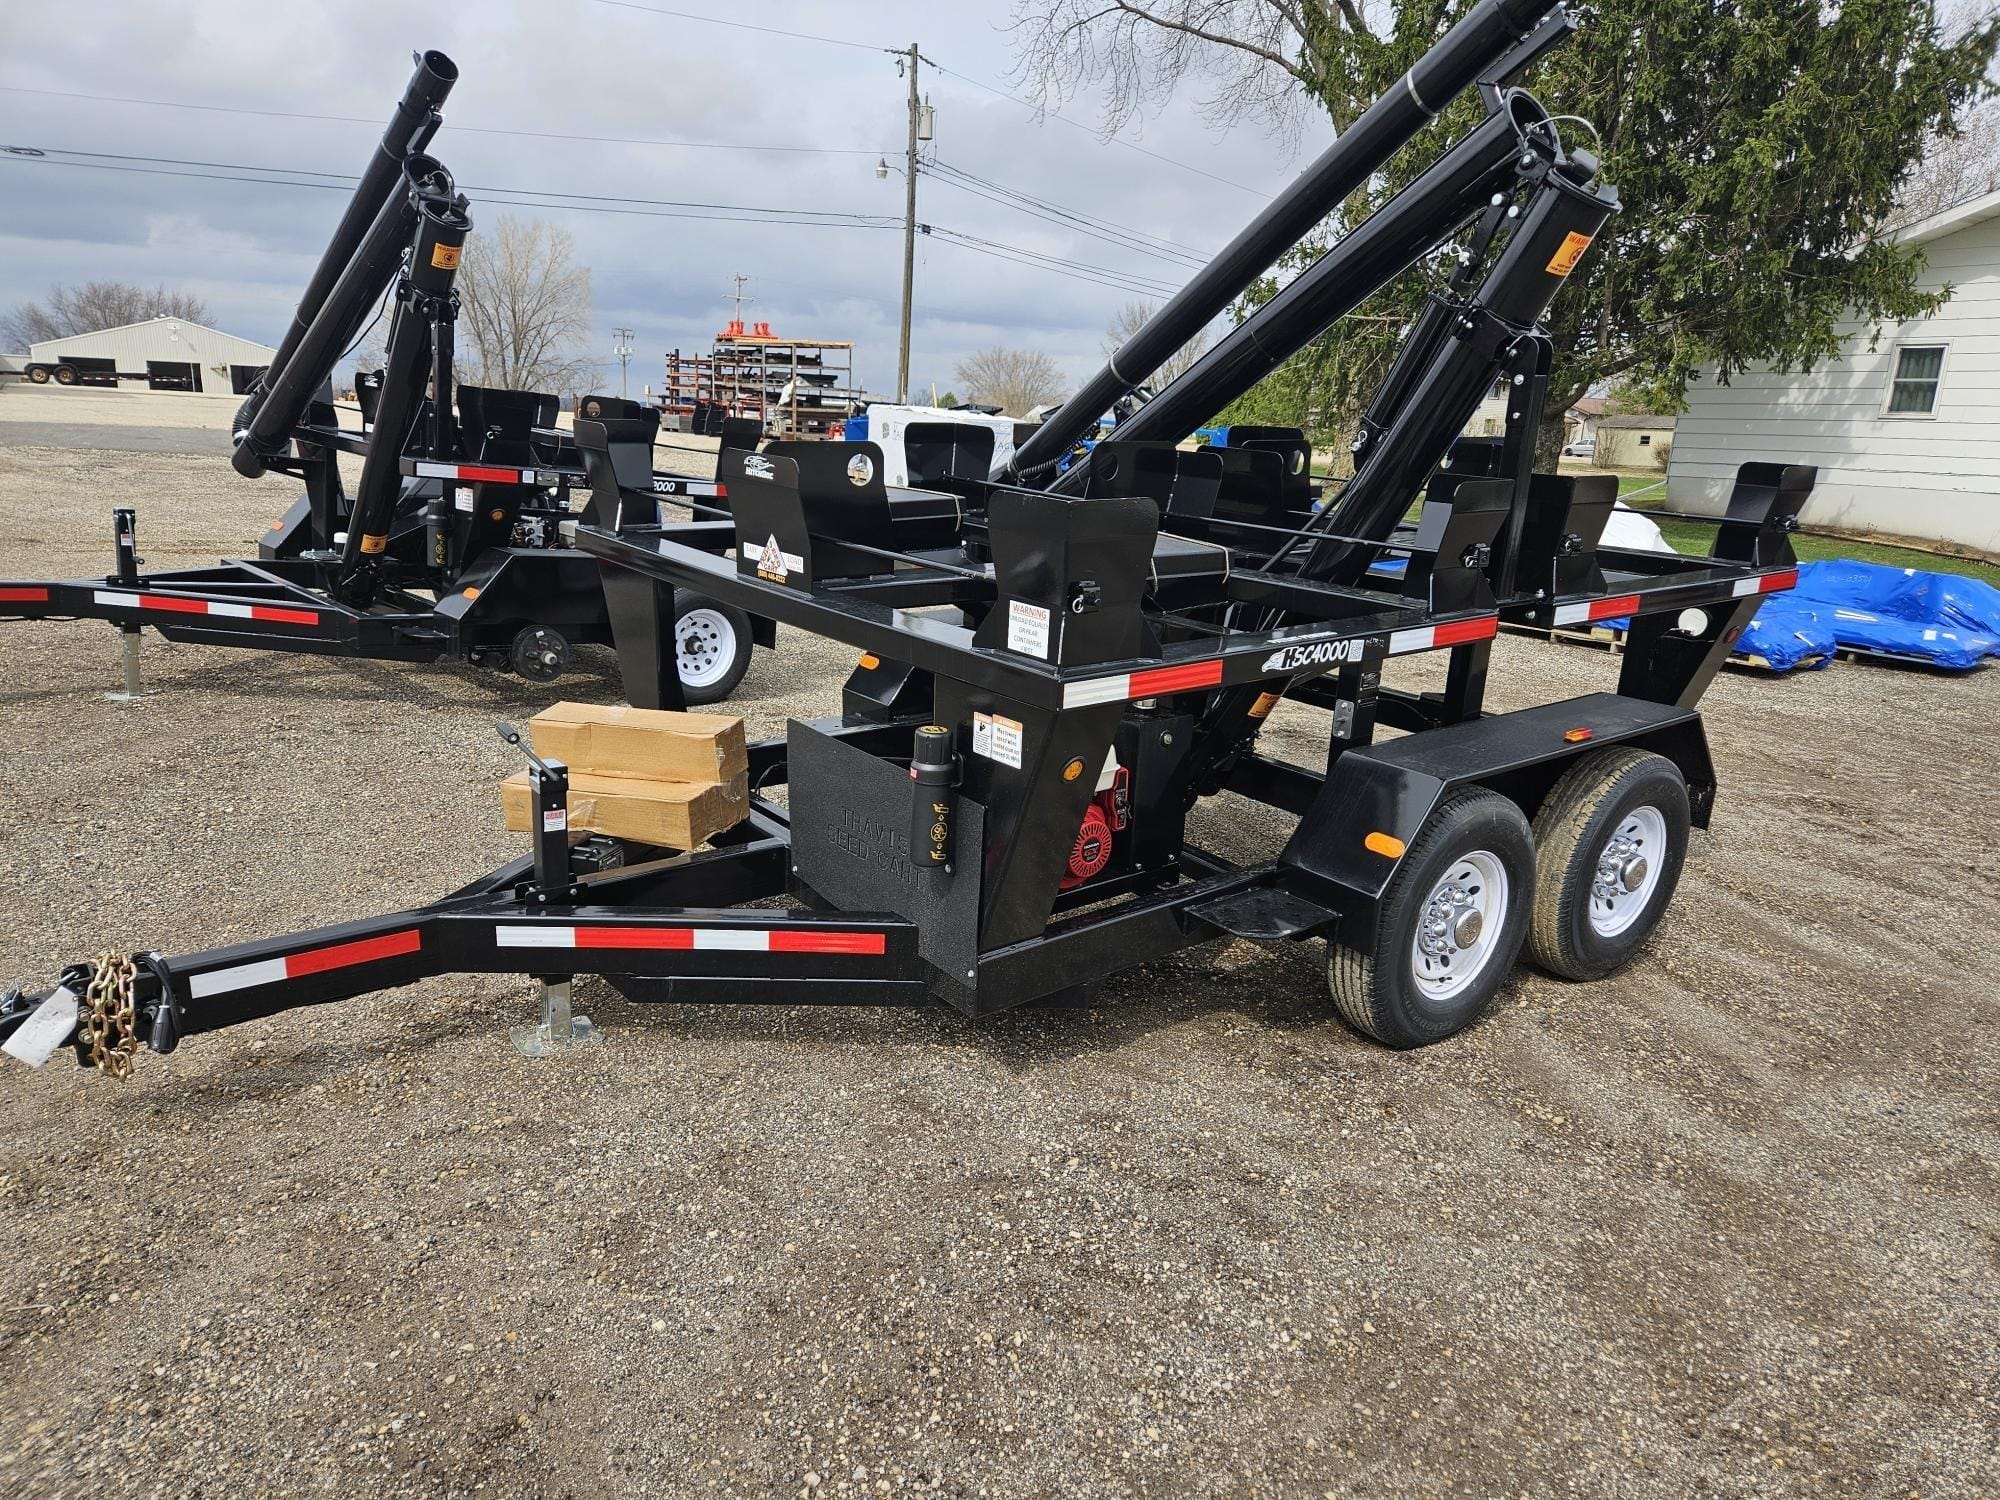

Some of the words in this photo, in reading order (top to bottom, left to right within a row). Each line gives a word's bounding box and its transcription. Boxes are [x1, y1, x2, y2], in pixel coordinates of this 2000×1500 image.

[1012, 603, 1047, 620] WARNING
[827, 823, 869, 860] SEED
[878, 850, 927, 889] CART
[841, 806, 908, 857] TRAVIS
